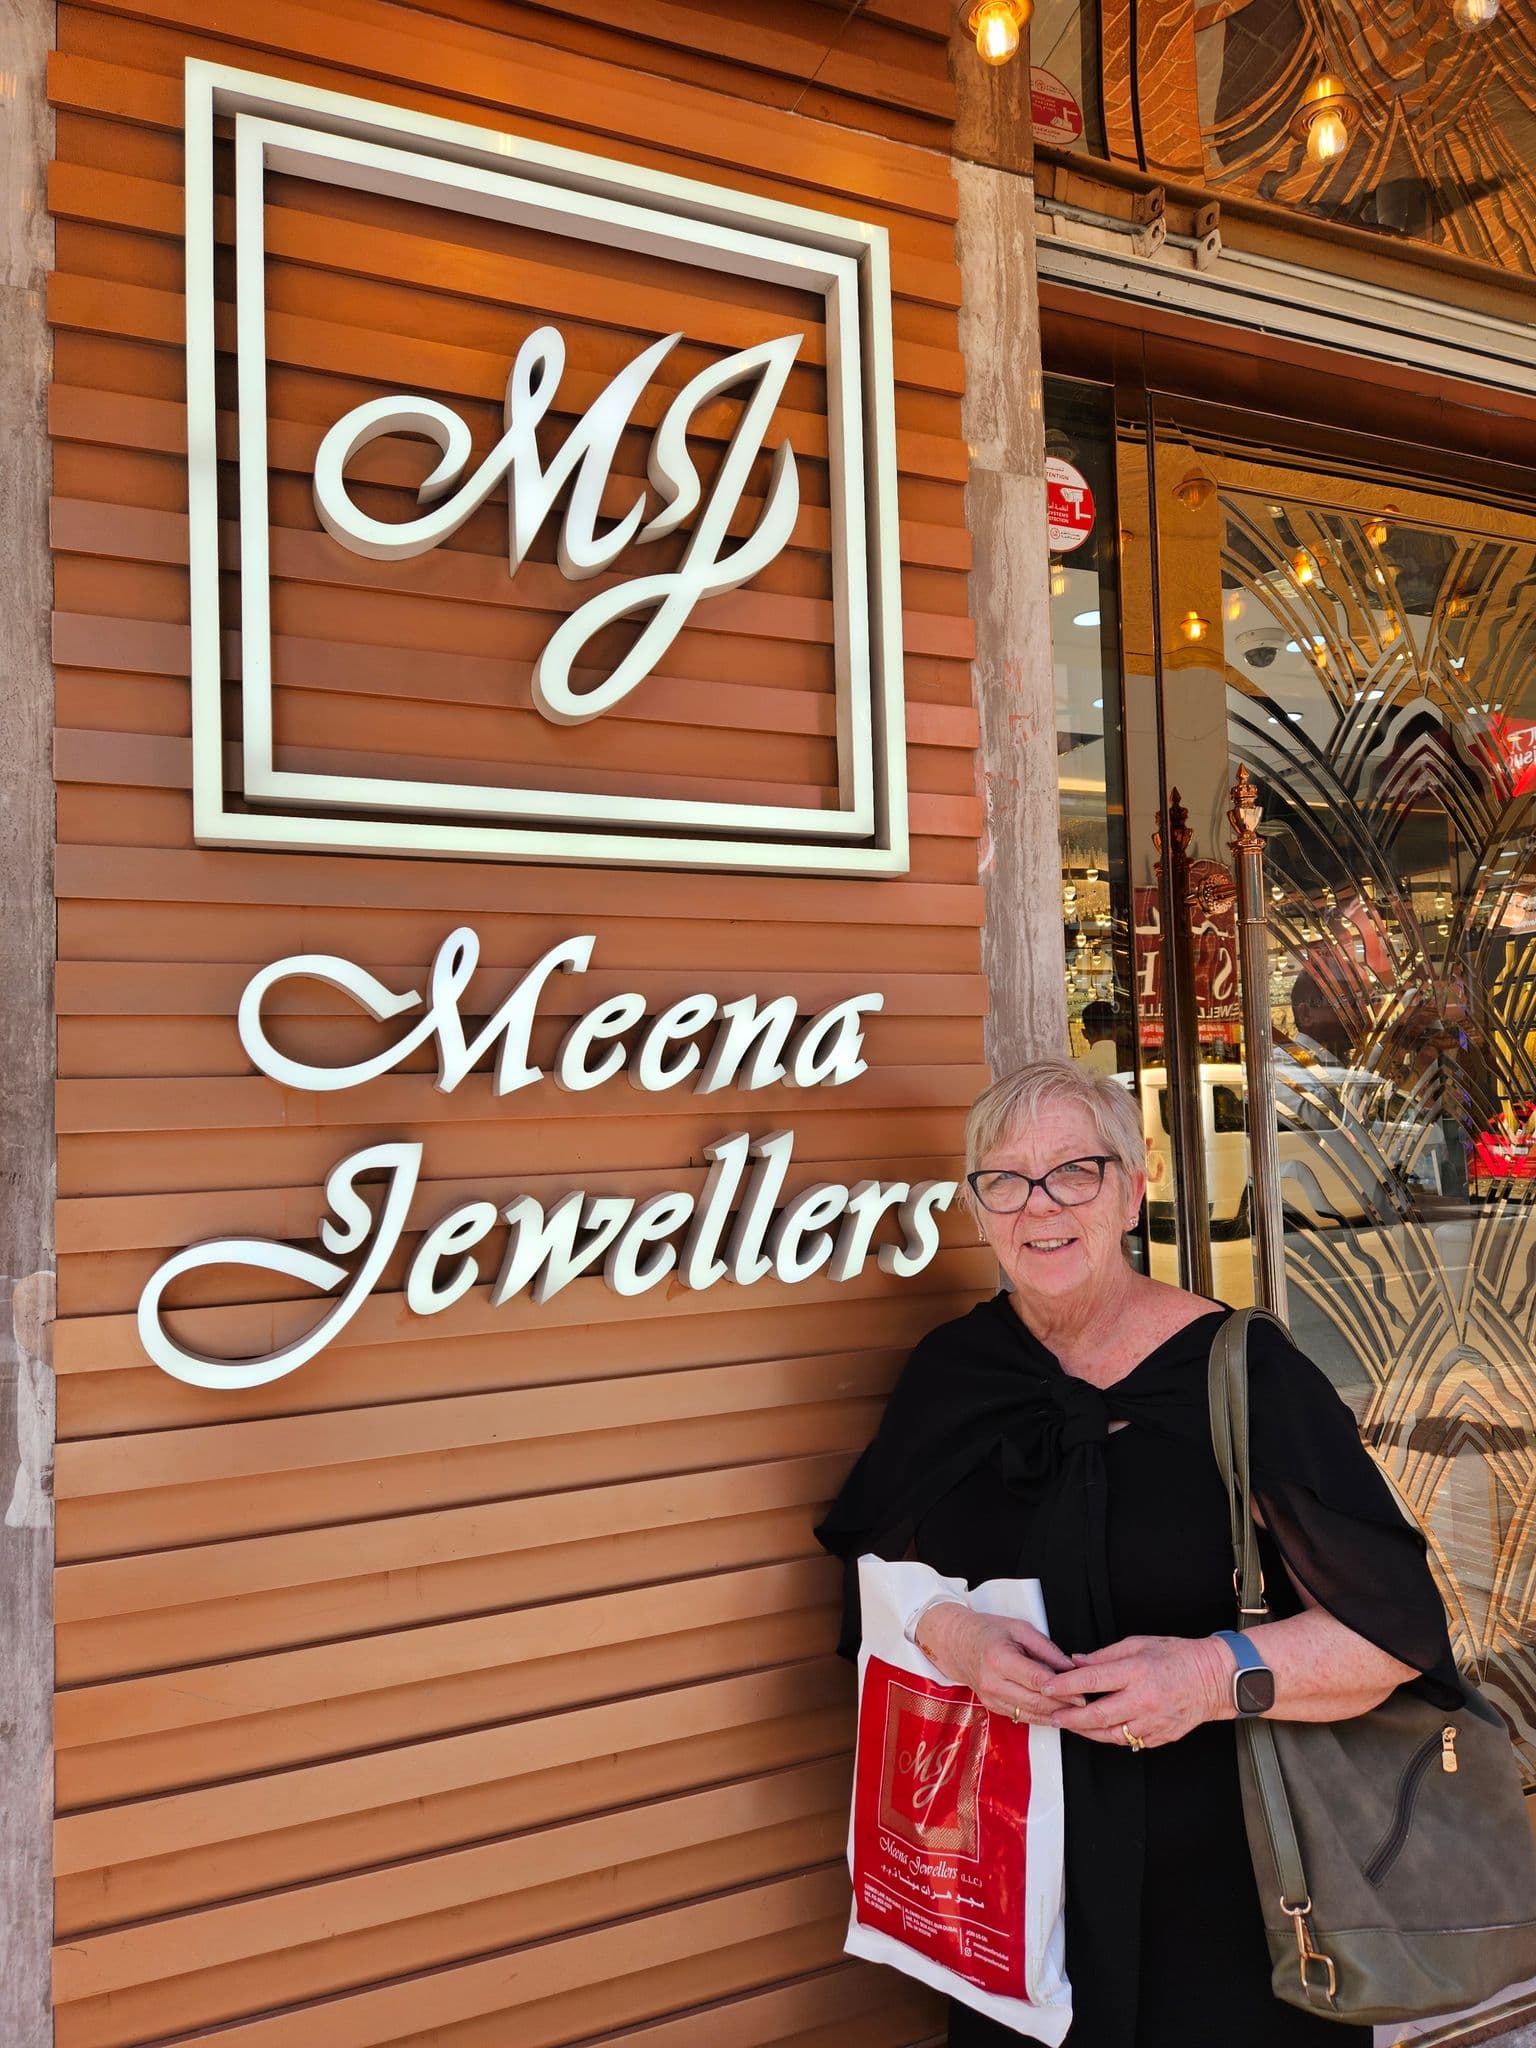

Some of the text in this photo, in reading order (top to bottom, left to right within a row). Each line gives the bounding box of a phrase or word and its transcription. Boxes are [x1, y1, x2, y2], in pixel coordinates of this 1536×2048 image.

[1046, 471, 1070, 481] TENTION
[238, 926, 883, 1096] Meena
[137, 1130, 958, 1389] Jewellers
[880, 1836, 908, 1865] Meena
[908, 1856, 959, 1879] Jewellers
